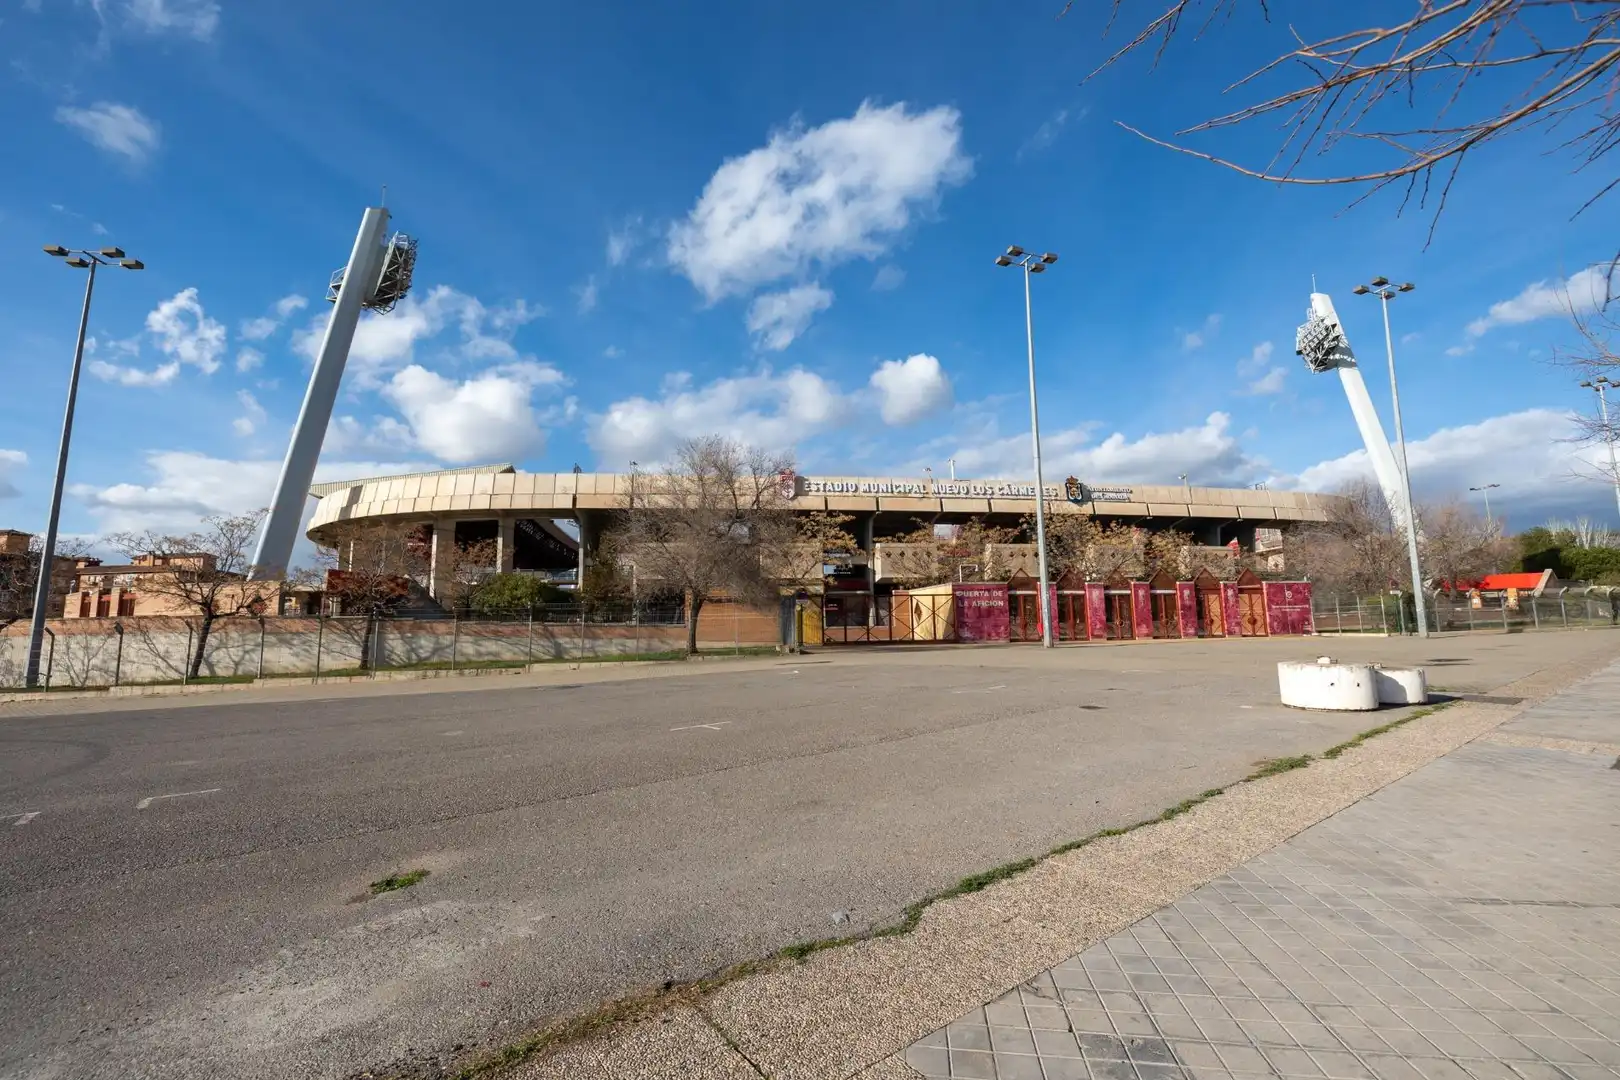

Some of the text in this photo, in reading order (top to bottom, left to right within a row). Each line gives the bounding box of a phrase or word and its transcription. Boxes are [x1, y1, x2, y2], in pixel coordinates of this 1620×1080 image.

[804, 481, 857, 492] ESTADIO
[860, 482, 927, 494] MUNICIPAL
[932, 484, 969, 495] NUEVO
[971, 484, 993, 495] LOS
